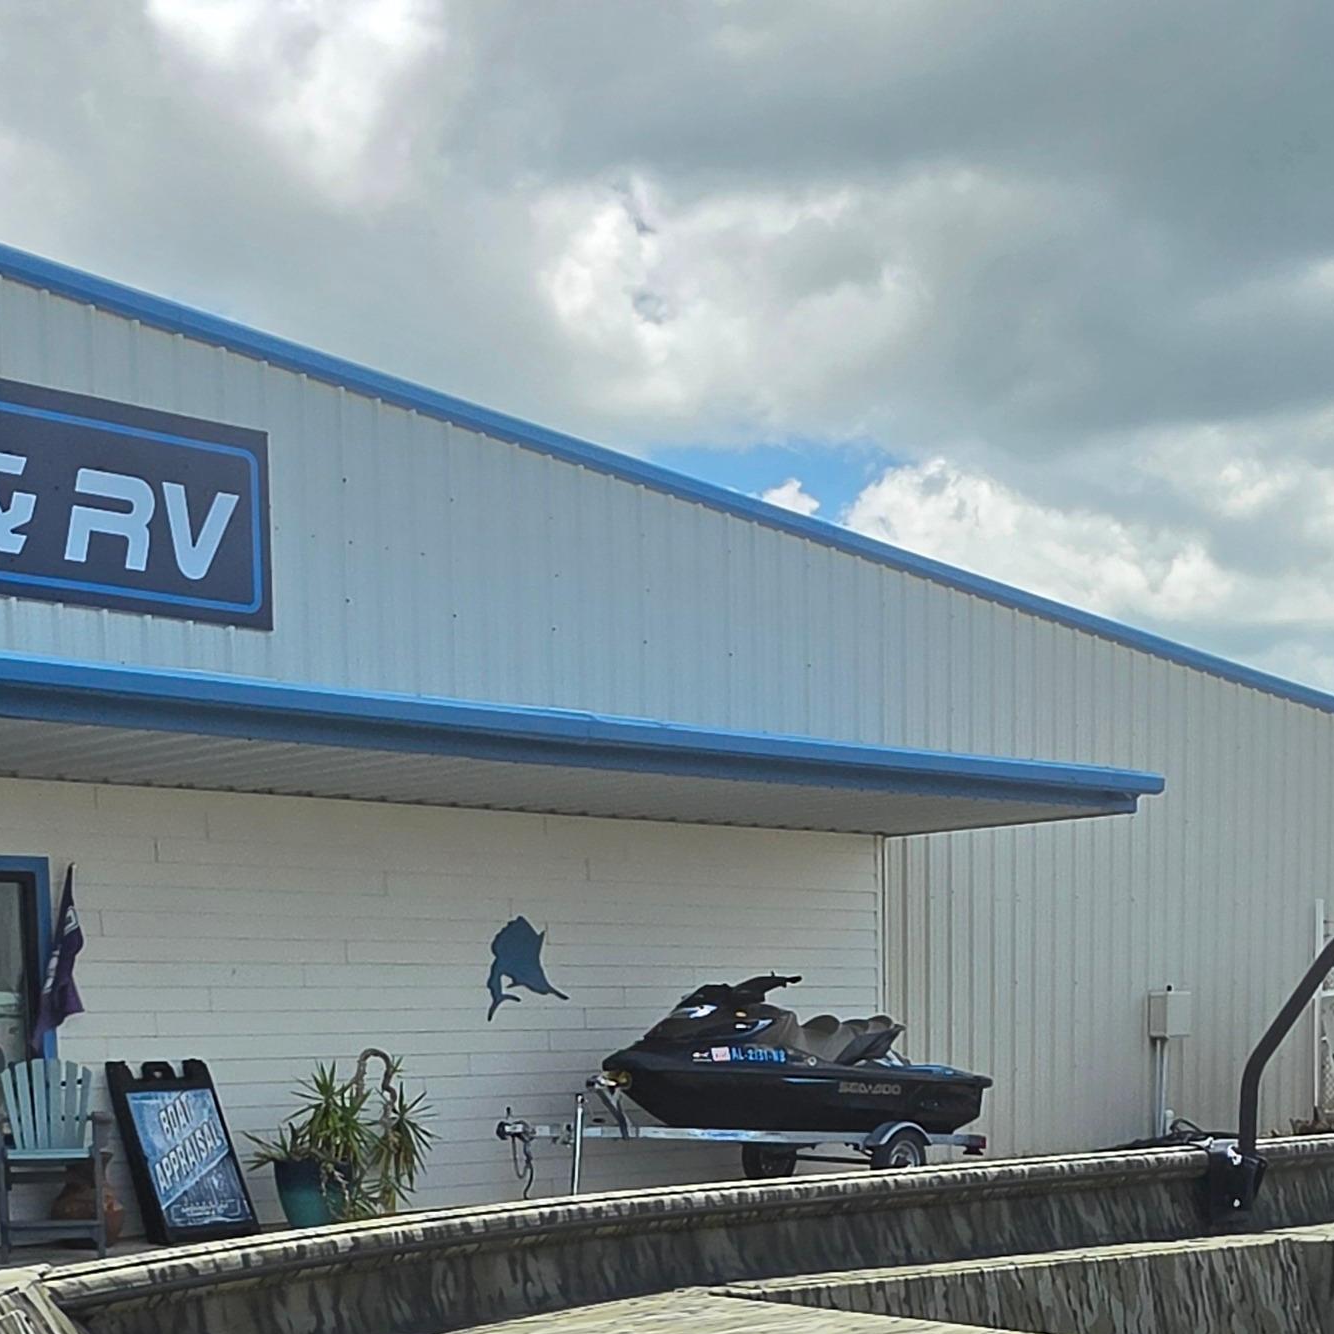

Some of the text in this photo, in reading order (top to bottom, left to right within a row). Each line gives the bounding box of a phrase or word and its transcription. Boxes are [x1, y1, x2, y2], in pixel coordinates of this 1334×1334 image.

[64, 467, 240, 580] RV
[159, 1092, 194, 1137] BOAT
[155, 1119, 223, 1194] APPRAISAL
